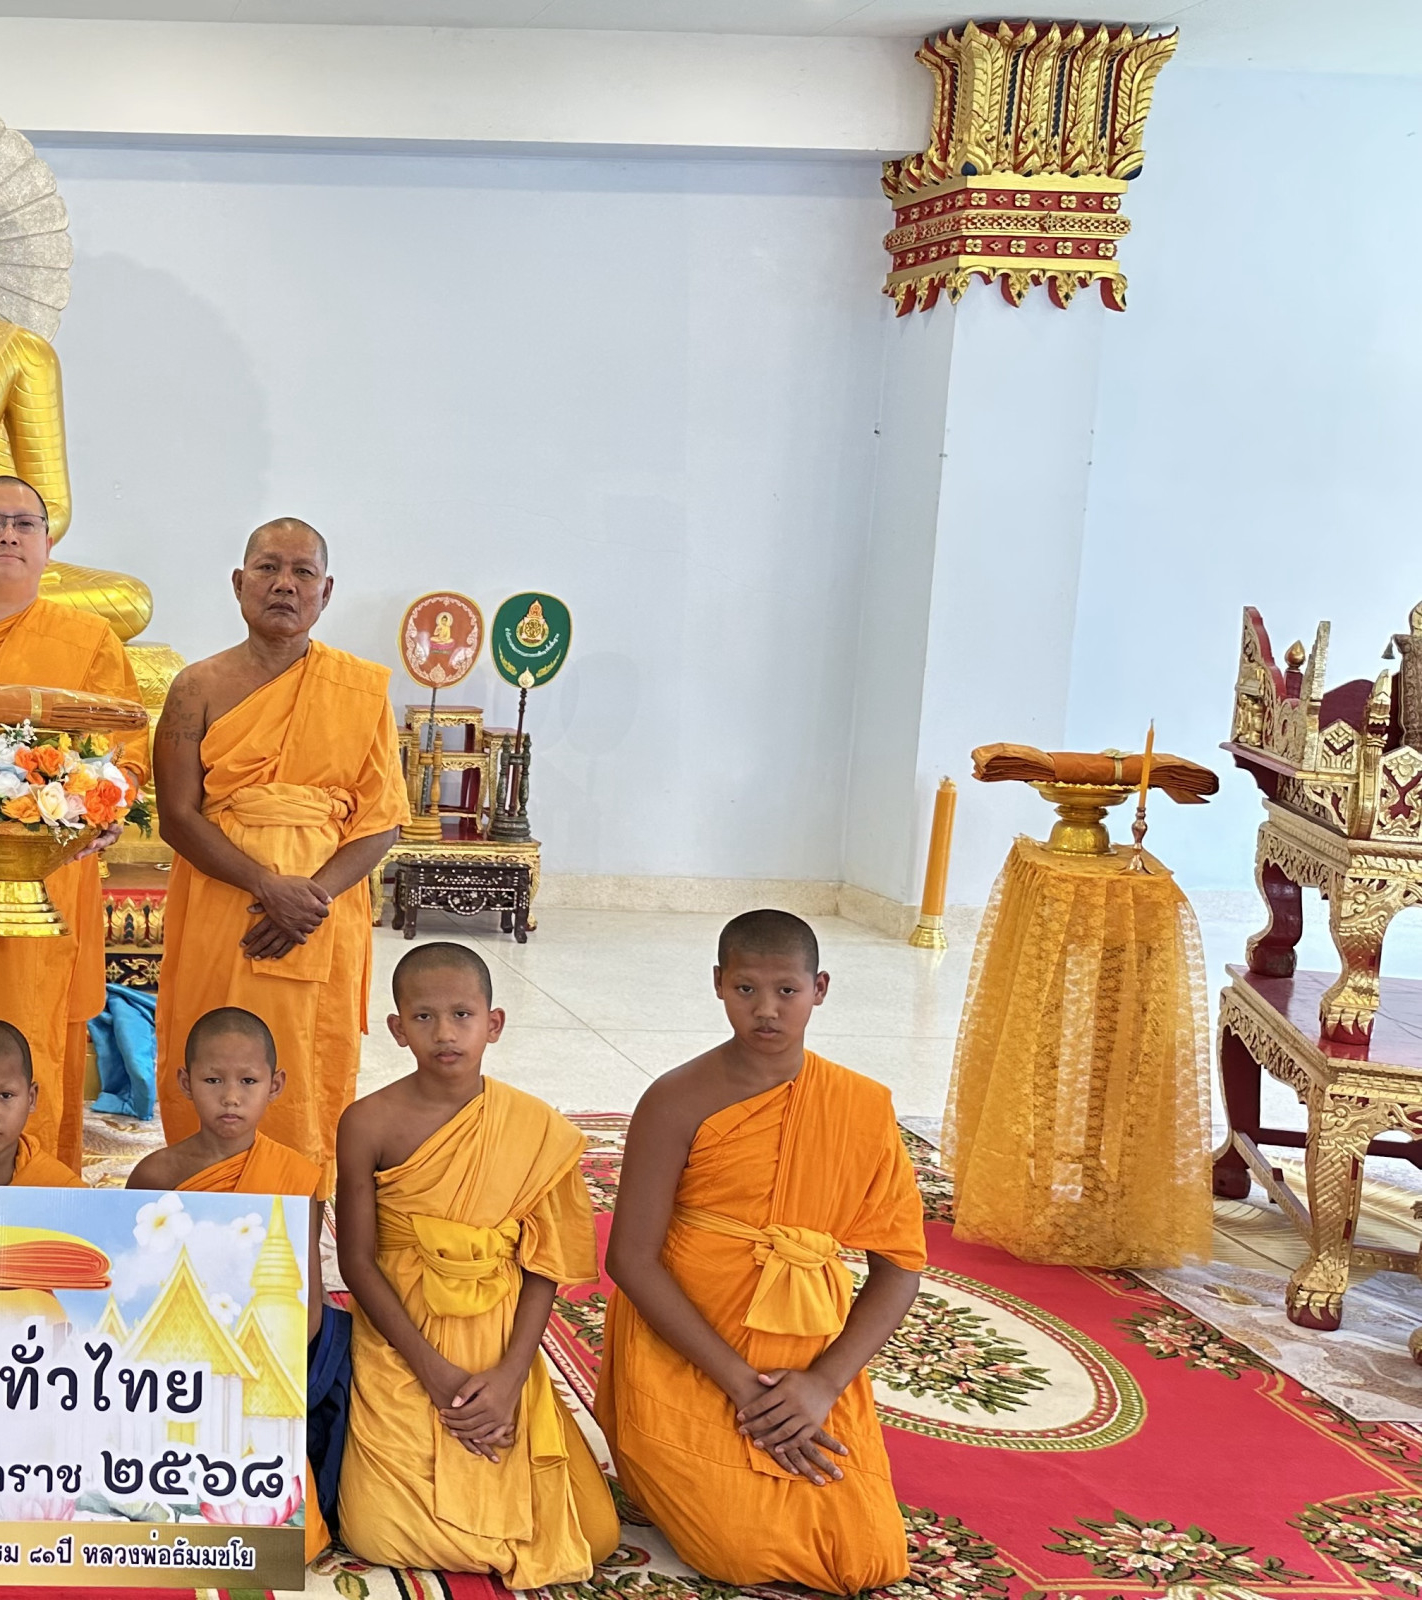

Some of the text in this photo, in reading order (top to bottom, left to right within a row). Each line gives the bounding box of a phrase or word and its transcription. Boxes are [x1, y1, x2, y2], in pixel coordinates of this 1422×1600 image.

[100, 1450, 284, 1499] ๒๕๖๘
[29, 1535, 73, 1565] ๘๑ปี
[82, 1531, 255, 1568] หลวงพ่อธัมมชโย
